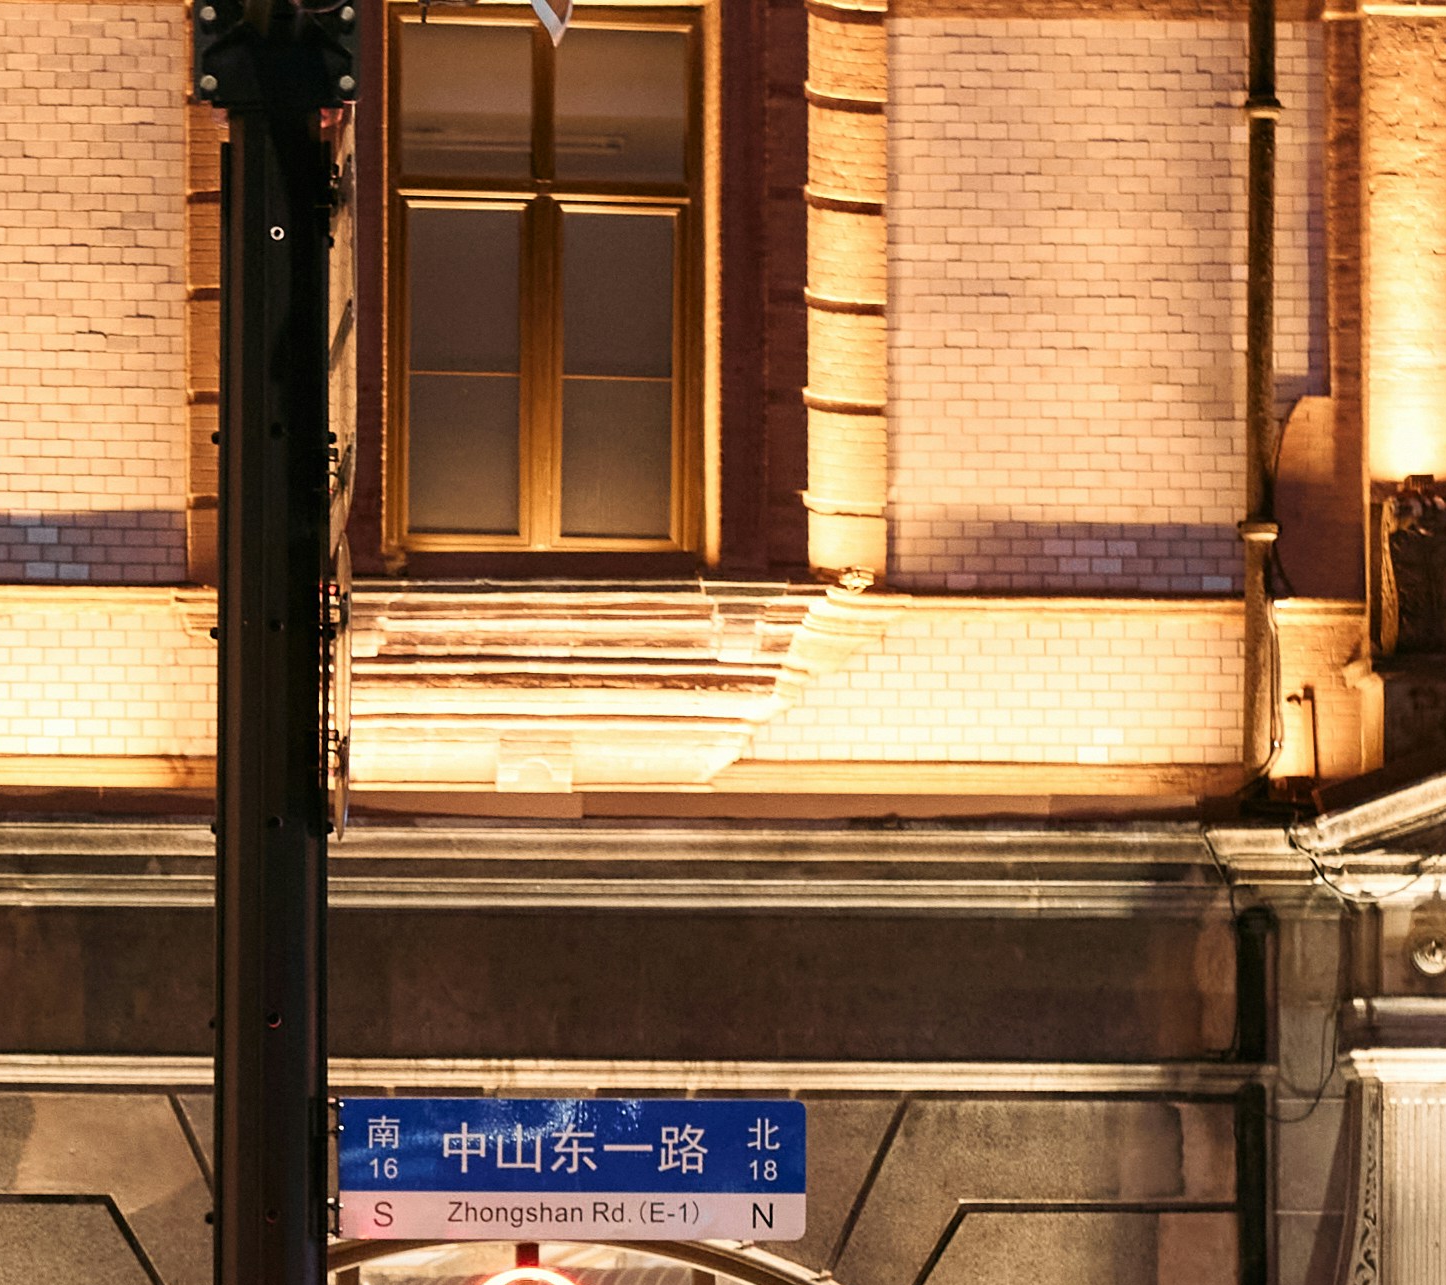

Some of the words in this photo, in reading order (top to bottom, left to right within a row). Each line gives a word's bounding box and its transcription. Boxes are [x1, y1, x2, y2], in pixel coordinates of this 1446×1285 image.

[367, 1115, 400, 1150] 南
[747, 1117, 781, 1151] 北
[443, 1121, 709, 1175] 中山东一路
[369, 1157, 399, 1179] 16
[749, 1159, 778, 1181] 18
[373, 1201, 394, 1227] S
[447, 1201, 583, 1228] Zhongshan
[592, 1202, 632, 1223] Rd.
[639, 1201, 700, 1225] (E-1)
[751, 1203, 774, 1229] N
